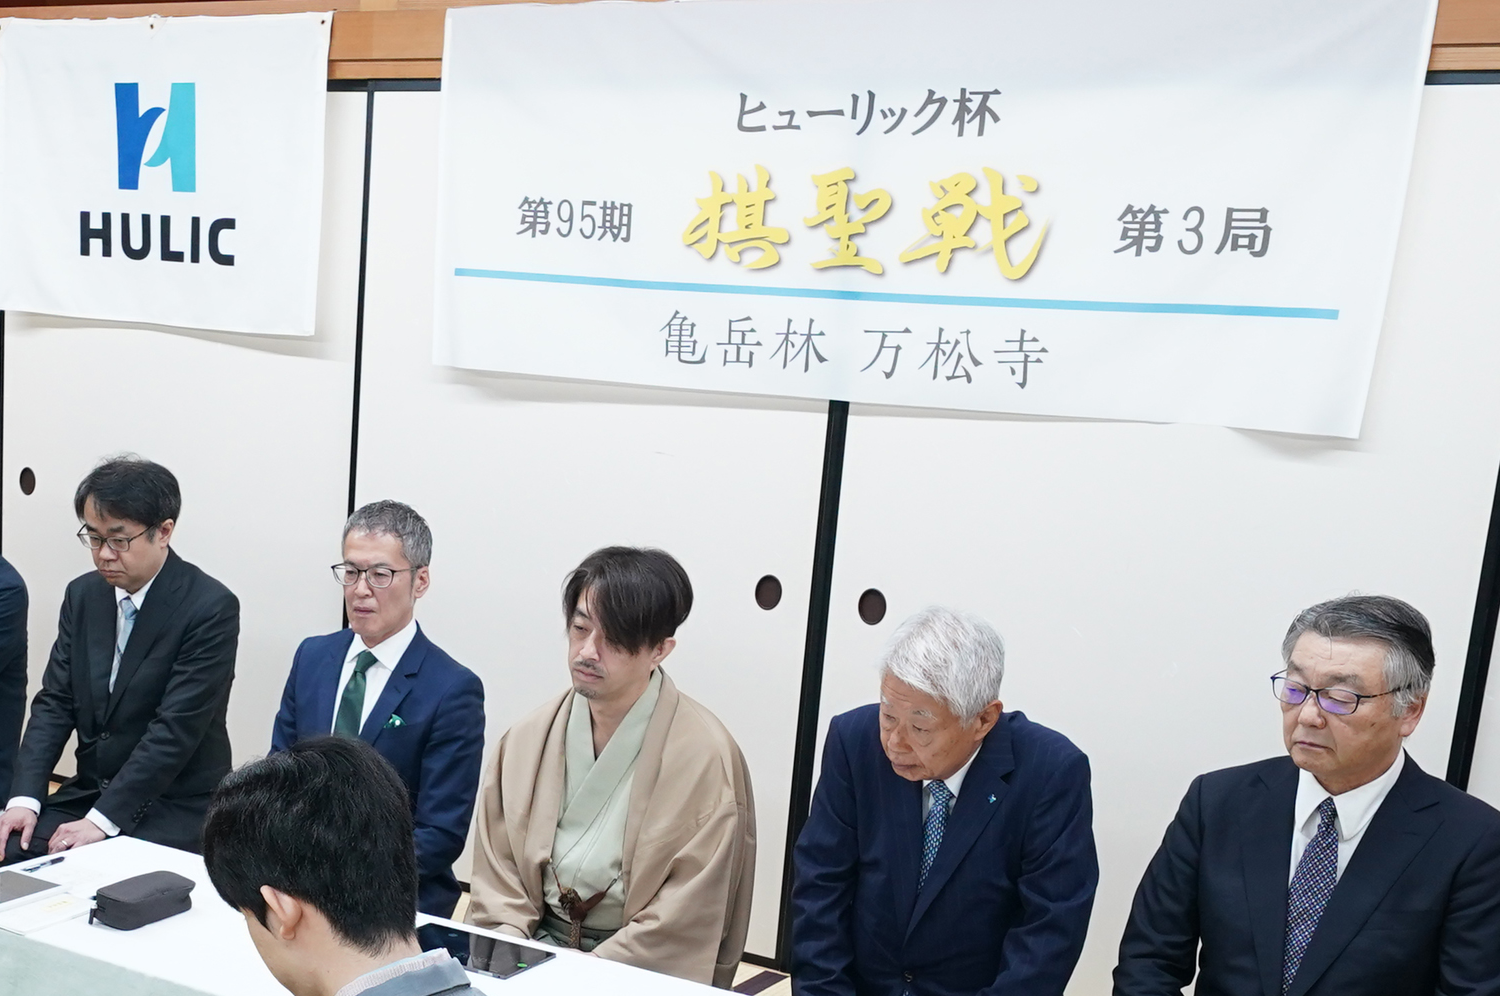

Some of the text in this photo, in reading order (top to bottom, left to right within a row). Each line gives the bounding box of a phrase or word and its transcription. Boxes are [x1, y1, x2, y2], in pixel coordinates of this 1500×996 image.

[736, 87, 1002, 138] ヒューリック杯
[80, 210, 236, 267] HULIC
[516, 163, 1273, 280] 第95期 棋聖戦 第3局
[660, 309, 1050, 390] 亀岳林 万松寺
